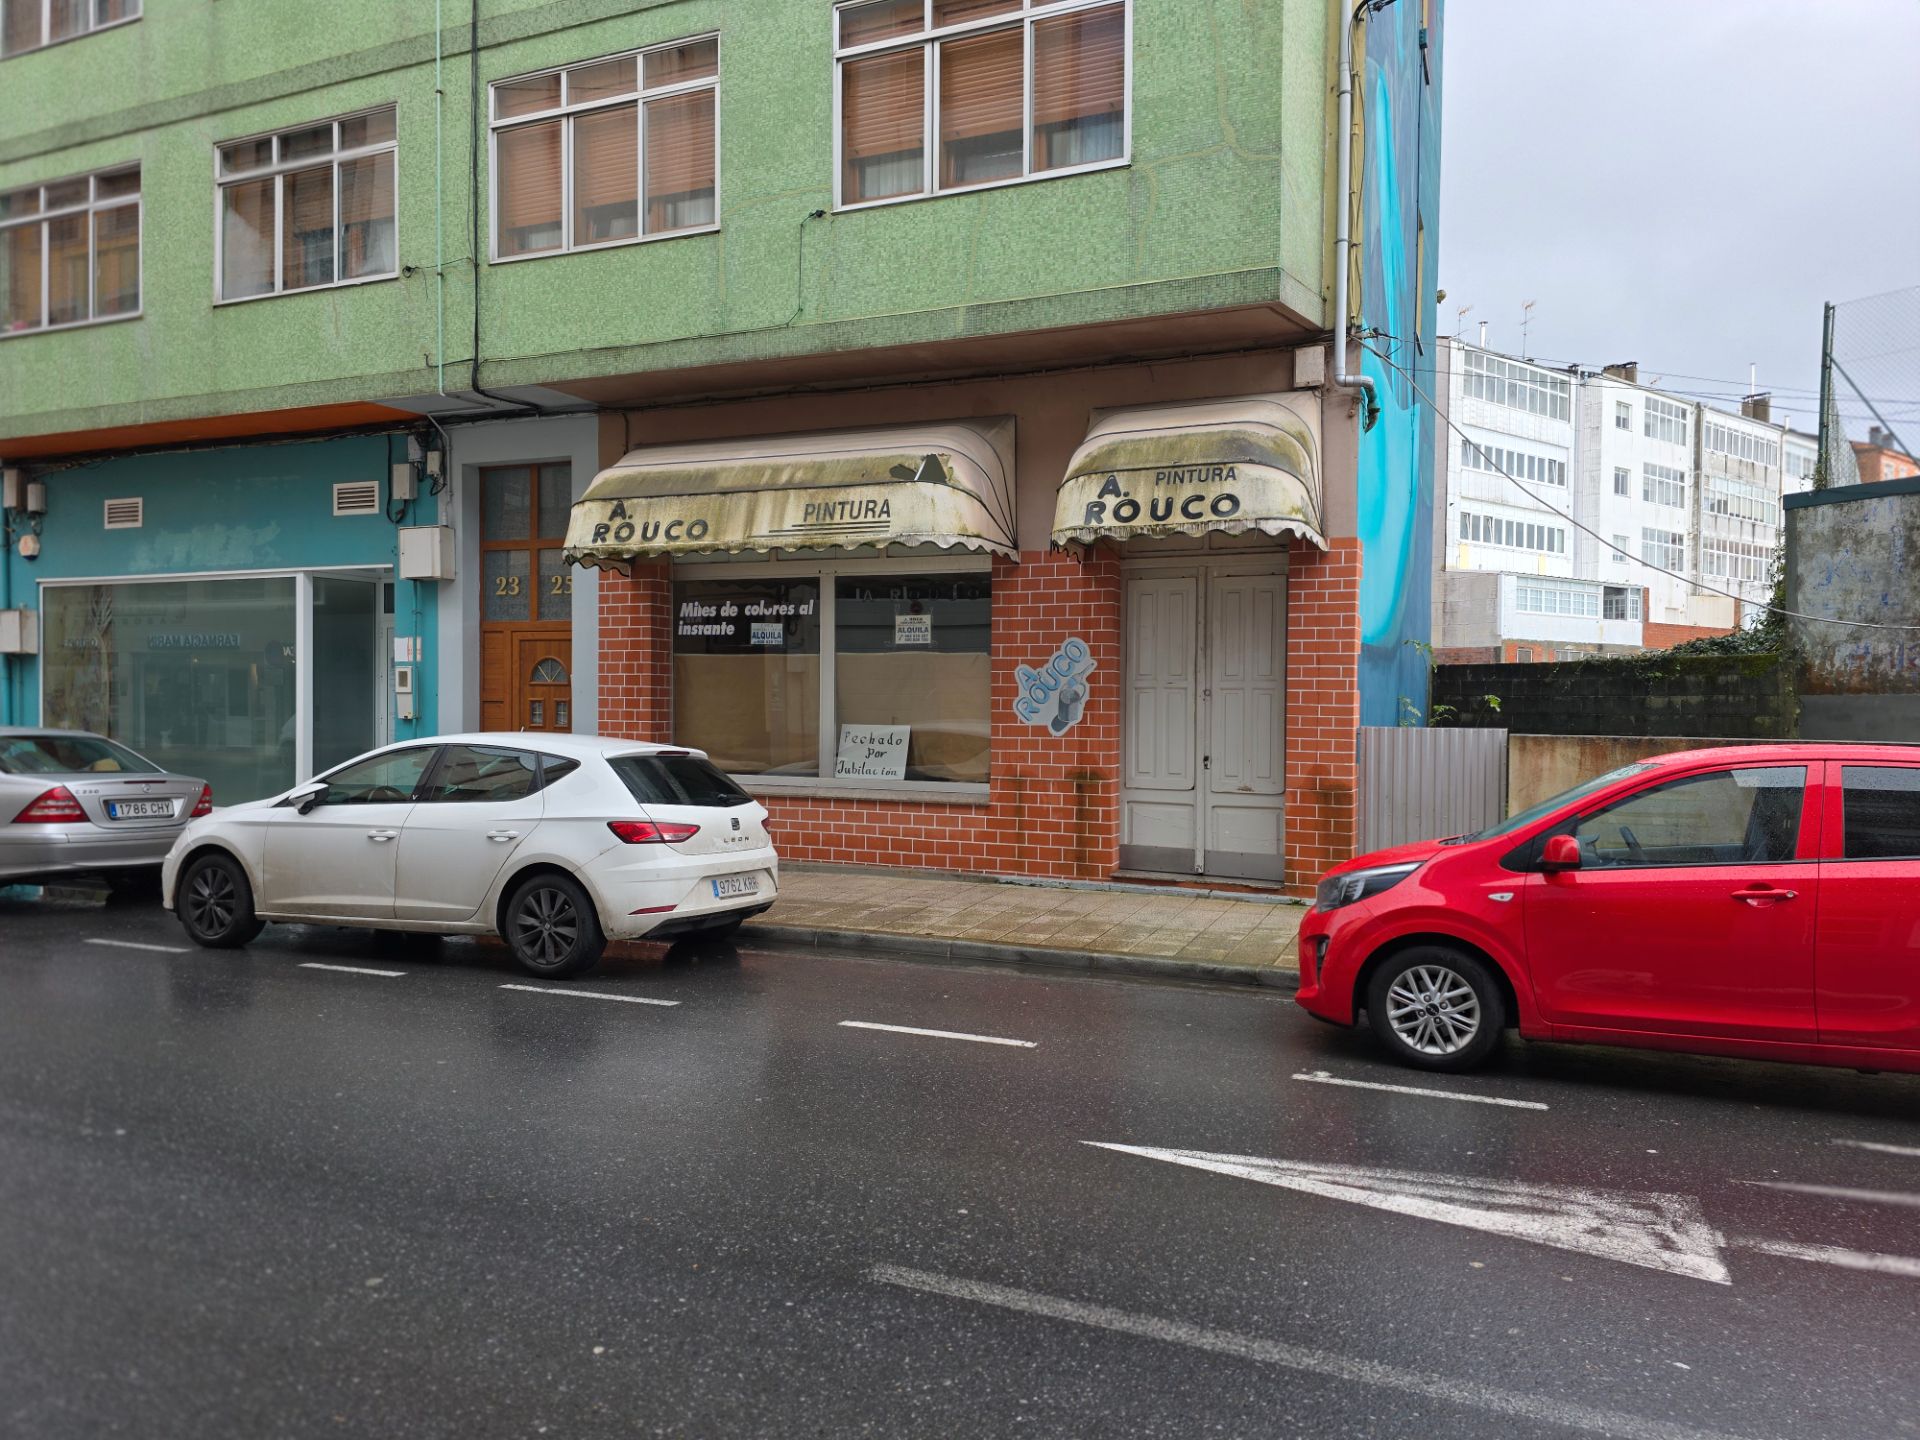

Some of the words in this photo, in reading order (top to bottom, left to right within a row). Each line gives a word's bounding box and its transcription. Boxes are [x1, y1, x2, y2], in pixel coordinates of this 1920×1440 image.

[1155, 466, 1237, 486] PINTURA
[1098, 474, 1130, 499] A.
[608, 499, 633, 521] A.
[803, 499, 891, 522] PINTURA
[1084, 493, 1240, 525] ROUCO
[592, 519, 709, 543] ROUCO
[495, 576, 520, 595] 23
[720, 600, 738, 617] de
[799, 599, 814, 615] al
[751, 631, 782, 640] ALQUILA
[896, 626, 929, 634] ALQUILA
[1016, 640, 1087, 722] ROUCO
[120, 803, 147, 815] 1786
[150, 803, 170, 814] CHY
[720, 879, 742, 894] 9762
